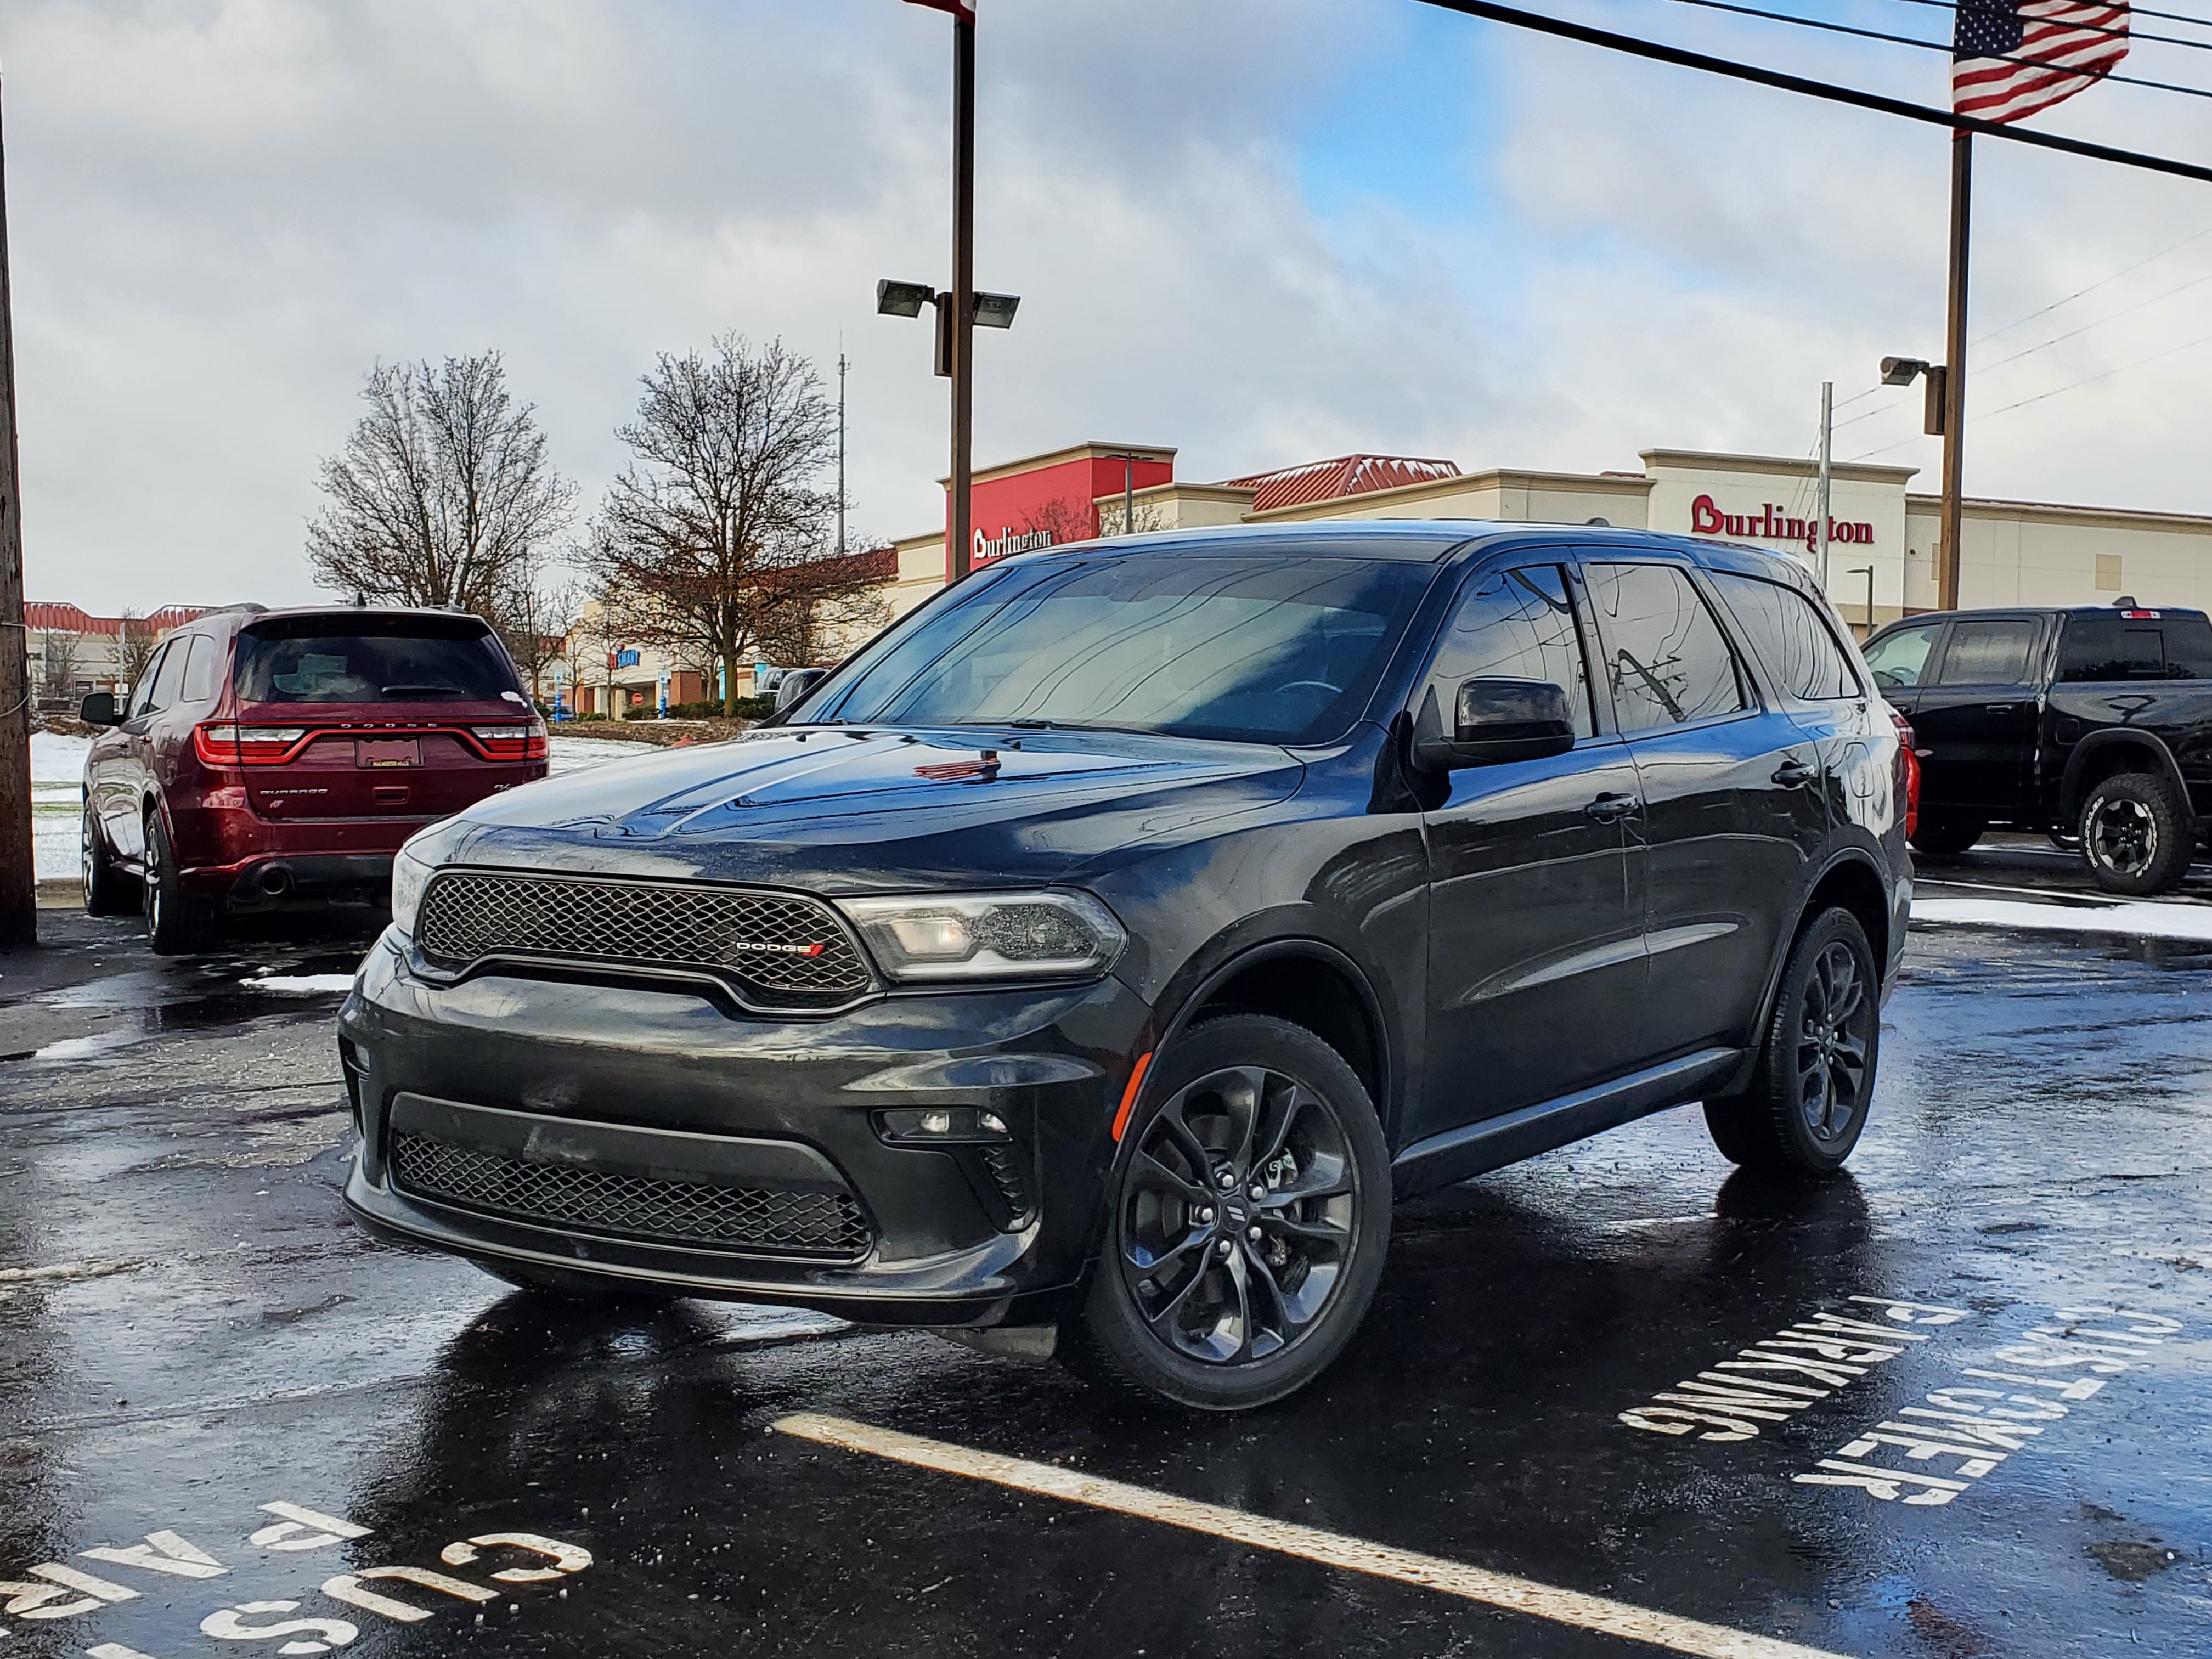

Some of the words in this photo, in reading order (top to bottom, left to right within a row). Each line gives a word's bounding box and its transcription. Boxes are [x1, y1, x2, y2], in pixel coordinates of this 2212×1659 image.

[974, 527, 1052, 558] Burlington
[1692, 494, 1874, 553] Burlington
[736, 942, 811, 953] DODGE
[1617, 1295, 1970, 1442] PARKING
[1791, 1305, 2183, 1506] CUSTOMER
[0, 1500, 375, 1637] PAR
[86, 1532, 594, 1659] CUS
